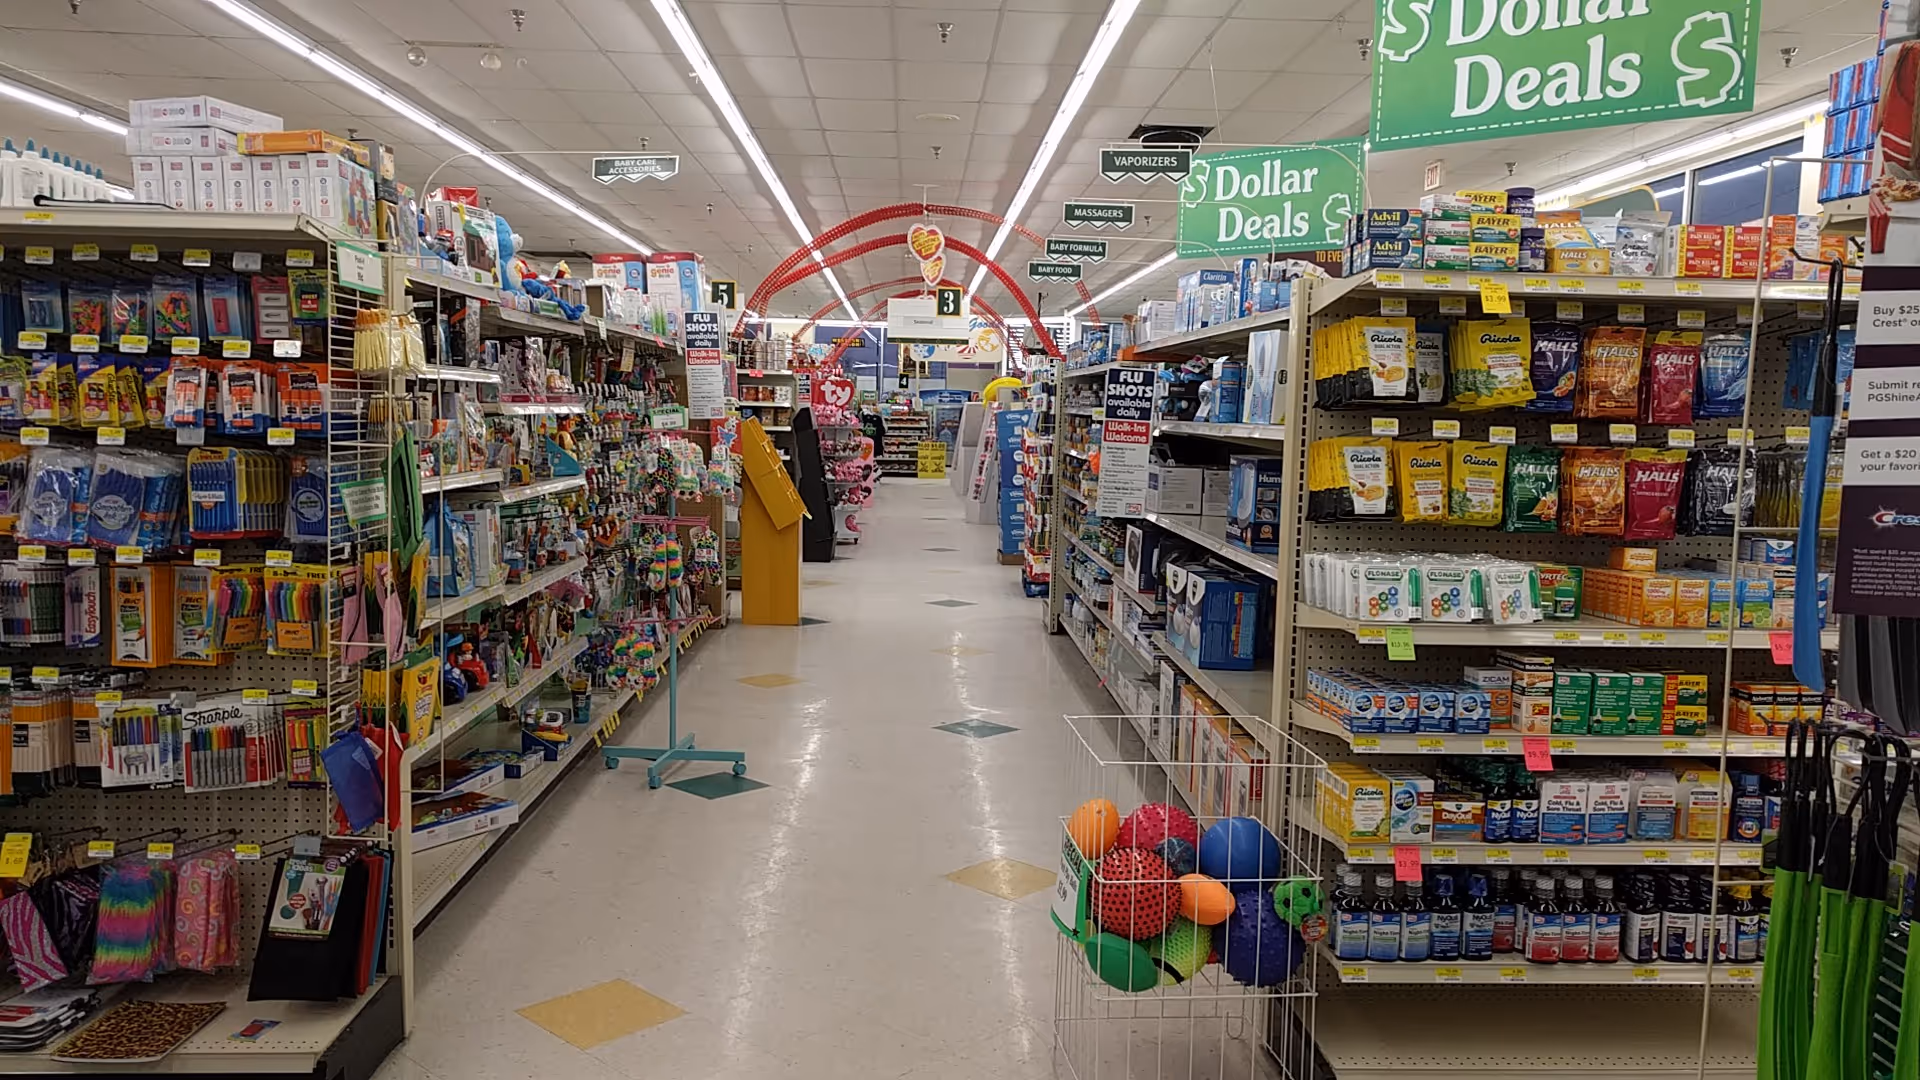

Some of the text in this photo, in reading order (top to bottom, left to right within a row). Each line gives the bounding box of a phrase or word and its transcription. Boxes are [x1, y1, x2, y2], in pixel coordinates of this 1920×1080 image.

[1450, 34, 1641, 118] Deals
[1114, 156, 1177, 167] VAPORIZERS
[608, 165, 661, 174] ACCESSORIES
[1214, 159, 1318, 201] Dollar
[1074, 208, 1123, 218] MASSAGERS
[1371, 211, 1400, 221] Advil
[1217, 201, 1309, 242] Deals
[1477, 217, 1510, 226] BAYER
[1050, 243, 1103, 253] BABY FORMULA
[1374, 241, 1402, 250] Advil
[1474, 246, 1508, 255] BAYER
[1203, 272, 1227, 281] Claritin
[717, 284, 729, 305] 5
[943, 290, 955, 313] 3
[1873, 305, 1920, 316] Buy $25
[693, 314, 711, 323] FLU
[686, 323, 718, 332] SHOTS
[687, 332, 718, 340] available
[1370, 334, 1403, 343] Ricola
[1480, 333, 1521, 343] Ricola
[694, 339, 712, 348] daily
[1416, 341, 1440, 350] Ricola
[1534, 339, 1578, 352] HALLS
[690, 350, 718, 358] Walk-Ins
[1597, 345, 1639, 358] HALLS
[1706, 344, 1749, 357] HALLS
[689, 357, 719, 365] Welcome
[1654, 353, 1696, 365] HALLS
[900, 376, 907, 386] 4
[1119, 371, 1143, 384] FLU
[1867, 380, 1908, 390] Submit
[820, 381, 851, 406] ty
[1108, 384, 1153, 397] SHOTS
[1107, 398, 1151, 409] available
[1116, 408, 1141, 419] daily
[1108, 421, 1146, 433] Walk-Ins
[1106, 432, 1147, 443] Welcome
[1350, 454, 1382, 463] Ricola
[1860, 449, 1917, 459] Get a $20
[1410, 458, 1441, 468] Ricola
[1463, 455, 1498, 467] Ricola
[1514, 463, 1558, 475] HALLS
[1578, 466, 1620, 478] HALLS
[1860, 463, 1886, 473] your
[1634, 470, 1680, 483] HALLS
[85, 592, 96, 634] EasyTouch
[183, 707, 243, 730] Sharpie
[293, 758, 310, 767] FREE
[1354, 788, 1384, 796] Ricola
[1442, 812, 1472, 820] DayQuil
[1491, 811, 1511, 820] NyQuil
[1516, 811, 1537, 820] NyQuil
